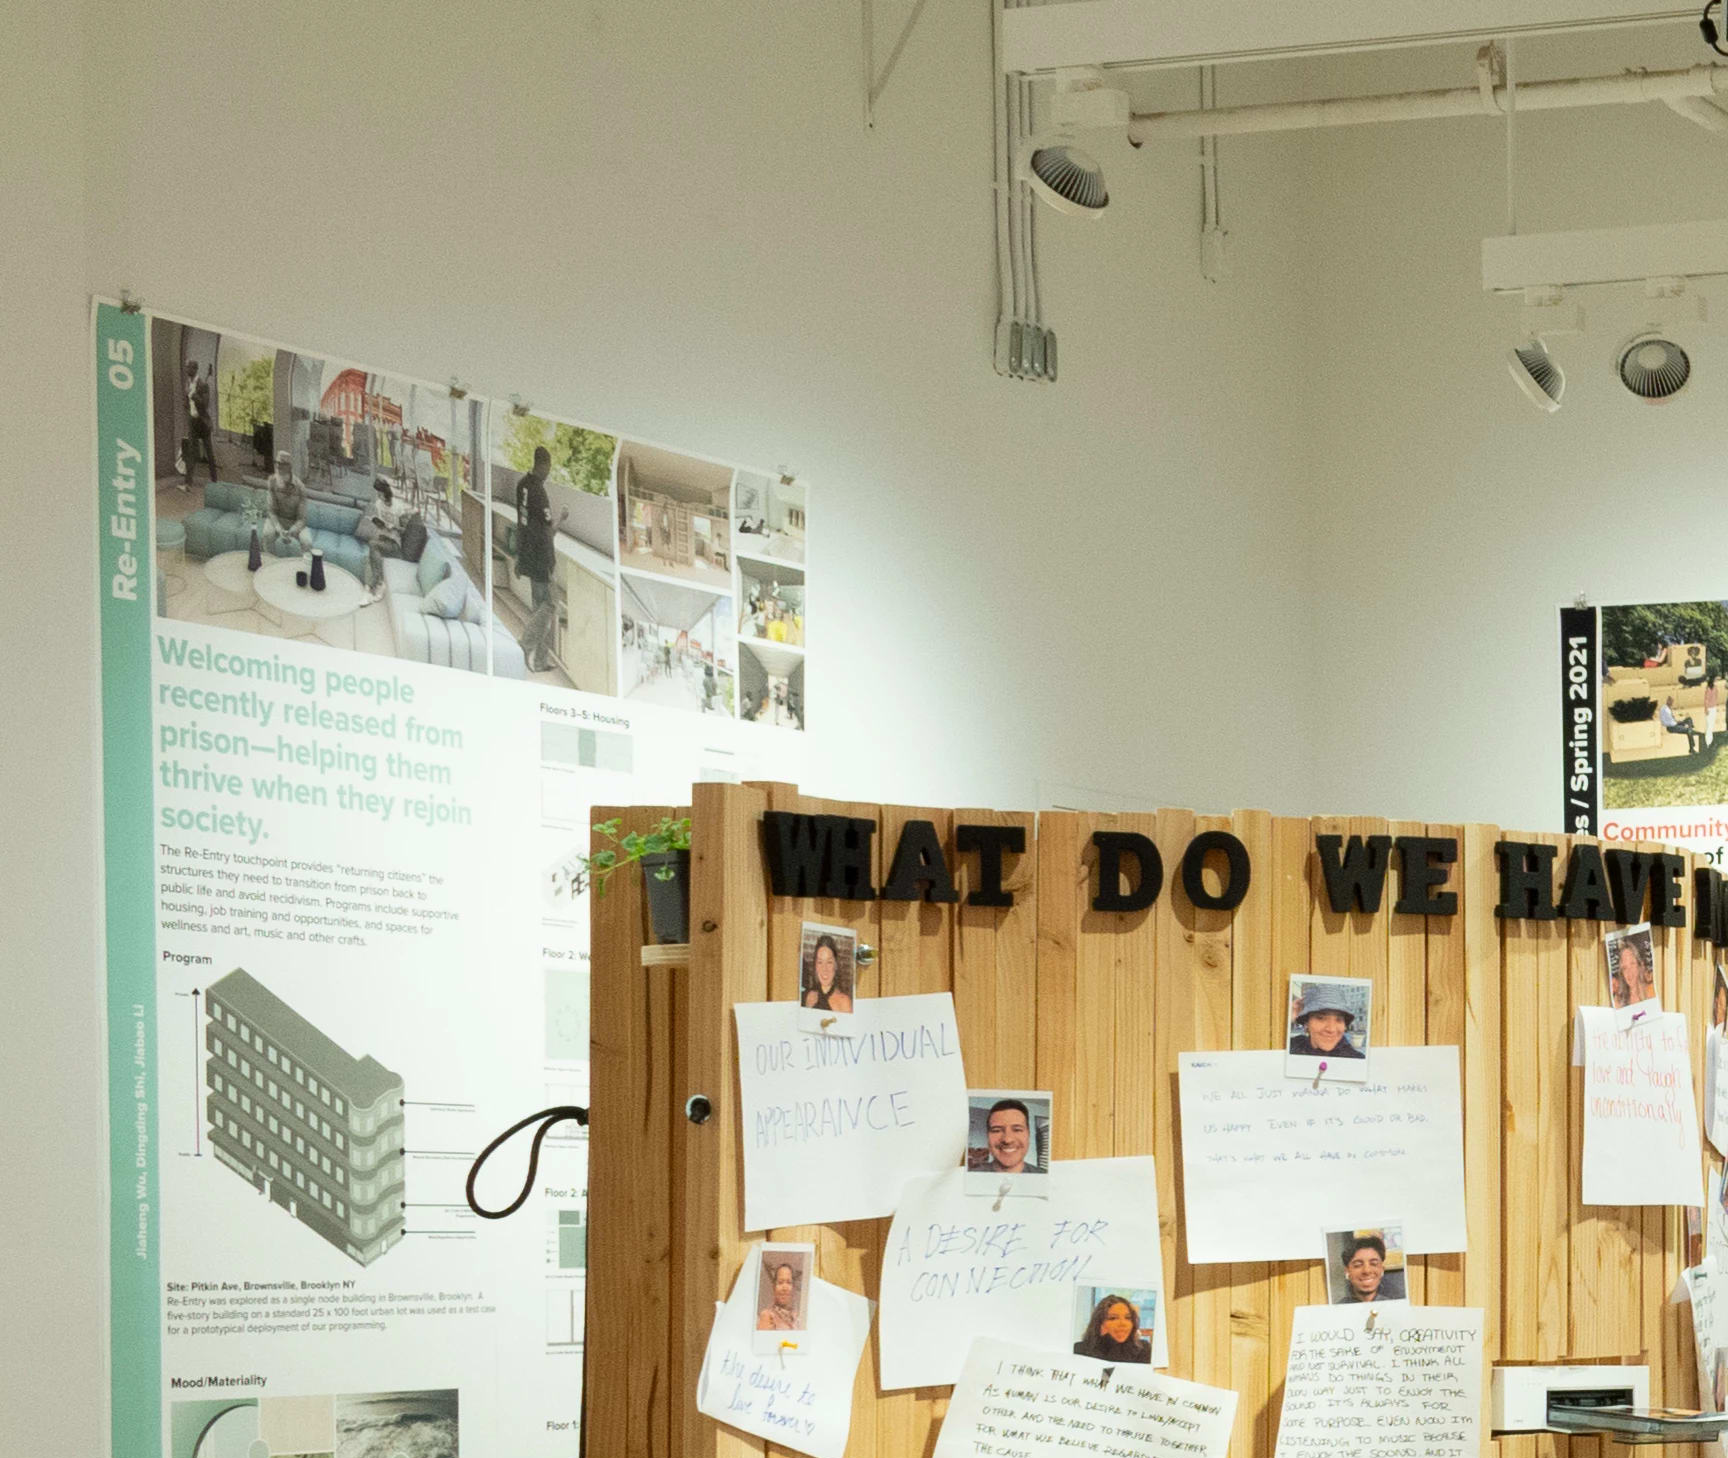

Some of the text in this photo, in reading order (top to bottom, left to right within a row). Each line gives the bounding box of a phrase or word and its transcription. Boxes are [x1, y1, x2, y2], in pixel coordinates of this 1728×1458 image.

[107, 338, 143, 602] Re-Entry 05
[157, 634, 414, 705] Welcoming people
[159, 681, 463, 749] recently released from
[1569, 636, 1592, 809] / Spring 2021
[160, 722, 451, 786] prison—helping them
[160, 761, 472, 828] thrive when they rejoin
[161, 804, 269, 844] society.
[764, 810, 1252, 913] WHAT DO
[1316, 834, 1458, 915] WE
[1494, 837, 1686, 928] HAVE
[162, 951, 212, 966] Program
[755, 1023, 955, 1076] OUR INDIVIDUAL
[755, 1091, 916, 1149] APPEARANCE
[898, 1219, 1109, 1265] A DESIRE FOR
[911, 1255, 1093, 1302] CONNECTION
[171, 1374, 267, 1390] Mood/Materiality
